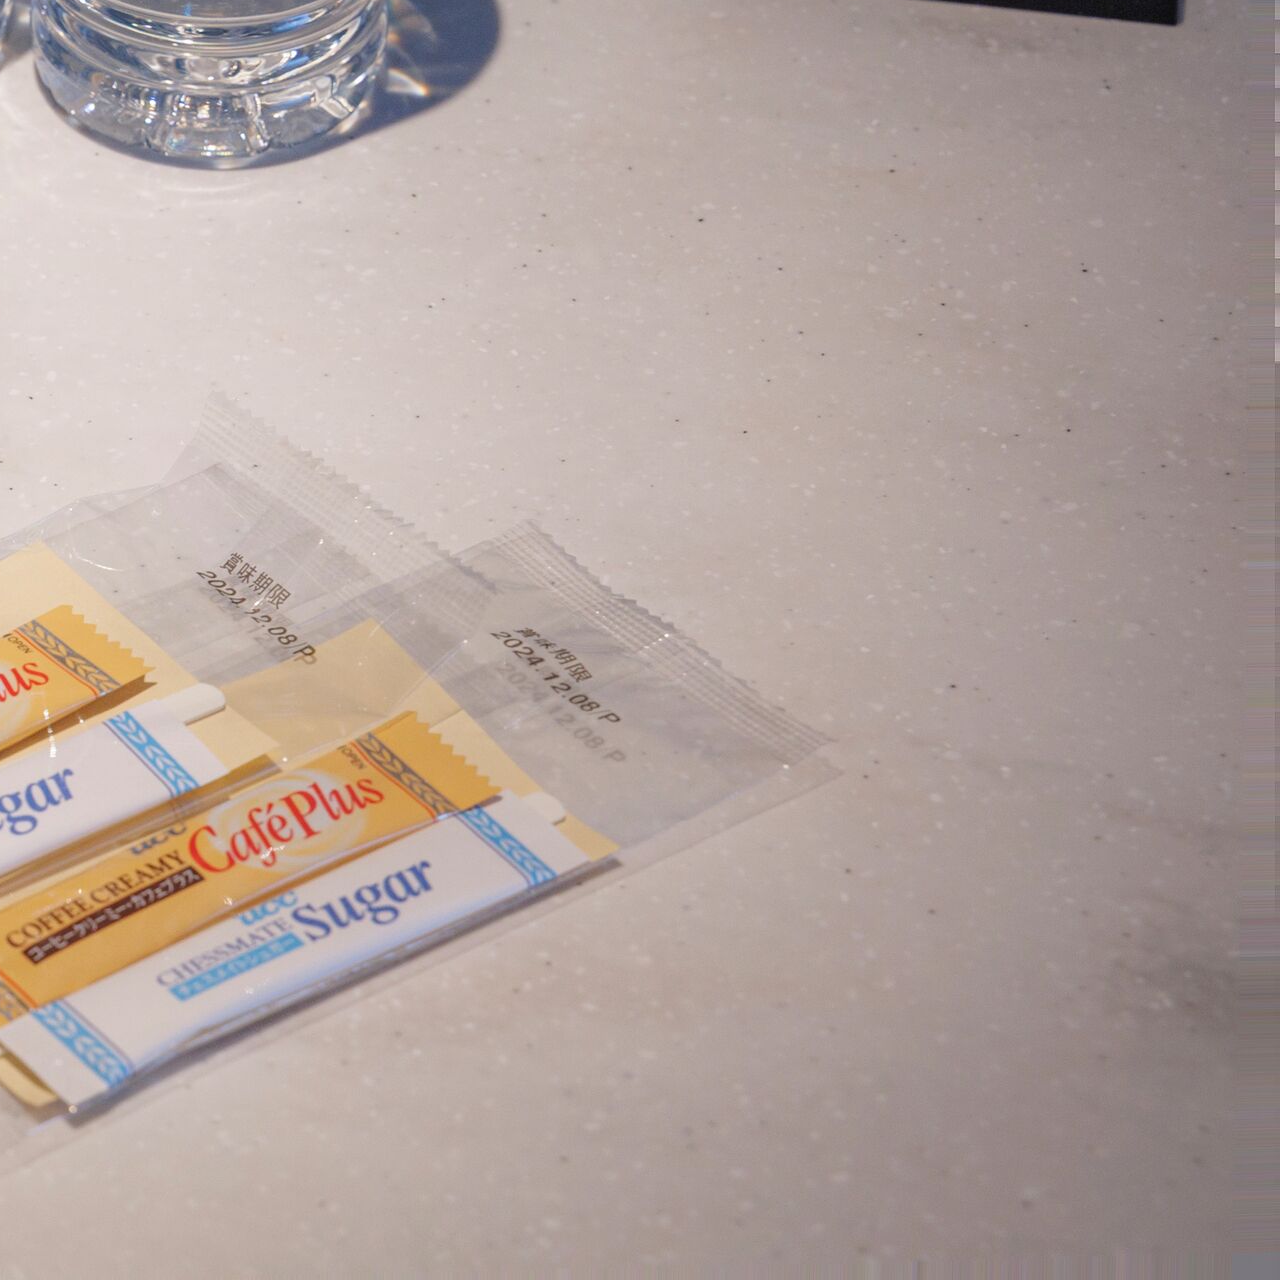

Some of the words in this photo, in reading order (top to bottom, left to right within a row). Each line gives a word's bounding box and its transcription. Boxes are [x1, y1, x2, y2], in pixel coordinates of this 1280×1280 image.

[220, 552, 291, 609] 賞味期限
[6, 895, 91, 948] COFFEE
[90, 849, 186, 904] CREAMY
[291, 860, 432, 942] Sugar
[156, 916, 293, 987] CHESSMATE
